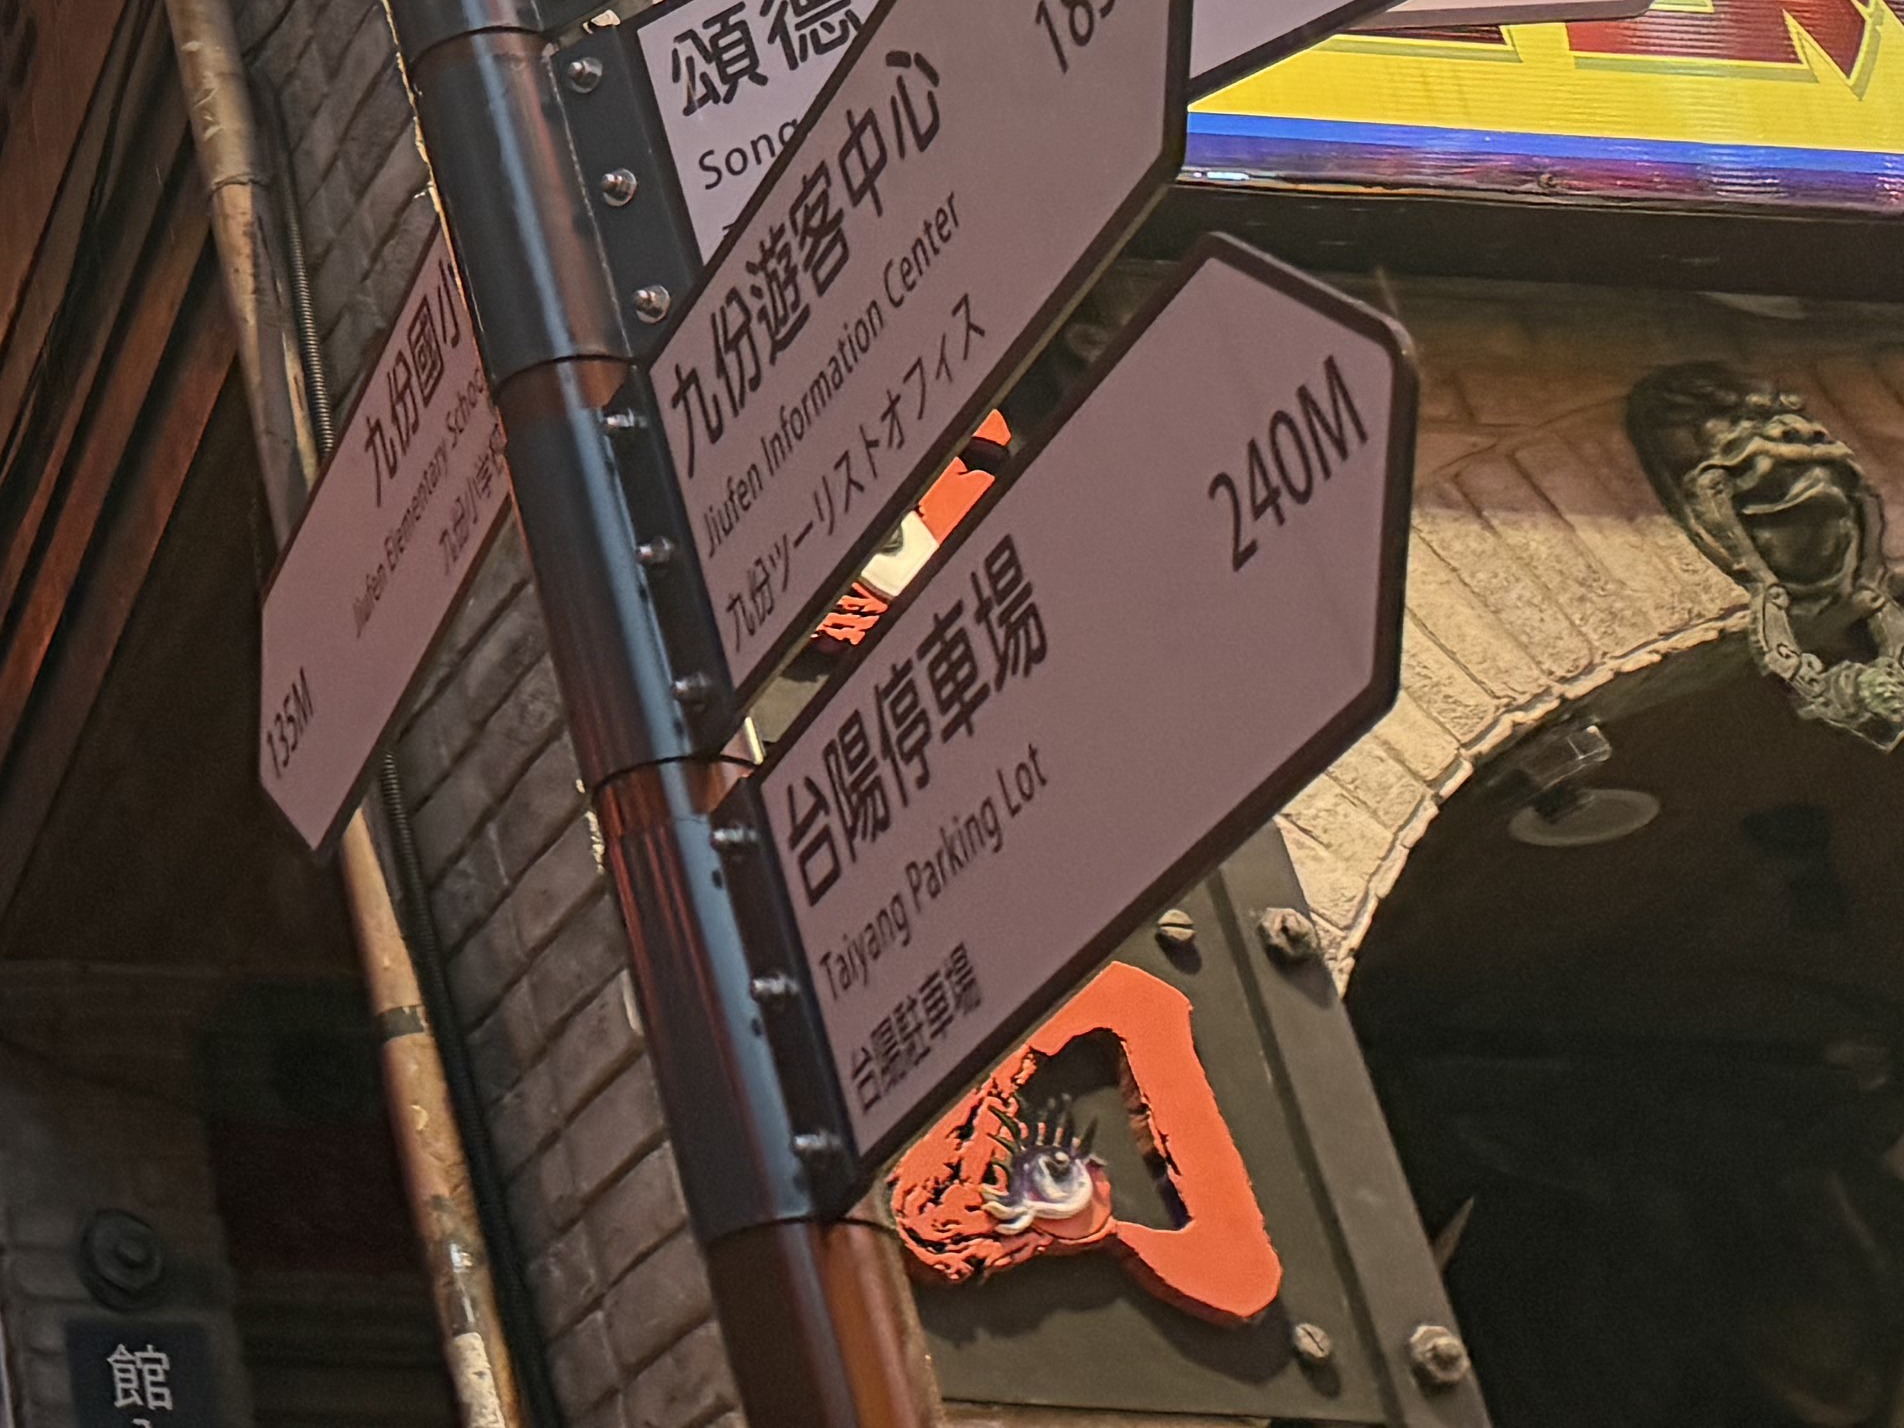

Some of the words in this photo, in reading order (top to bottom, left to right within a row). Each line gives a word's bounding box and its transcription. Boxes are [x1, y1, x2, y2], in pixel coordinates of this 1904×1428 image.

[671, 50, 941, 479] 九份遊客中心
[704, 458, 764, 559] Jiufen
[763, 299, 885, 468] Information
[885, 191, 960, 308] Center
[385, 436, 449, 573] Elementary
[446, 366, 486, 450] Schoo
[727, 293, 986, 652] 九份ツーリストオフィス
[1209, 354, 1370, 573] 240M
[266, 666, 315, 780] 135M
[788, 533, 1049, 908] 台陽停車場
[819, 887, 908, 1004] Taiyang
[907, 804, 1000, 908] Parking
[1000, 743, 1051, 850] Lot
[106, 1343, 173, 1411] 館
